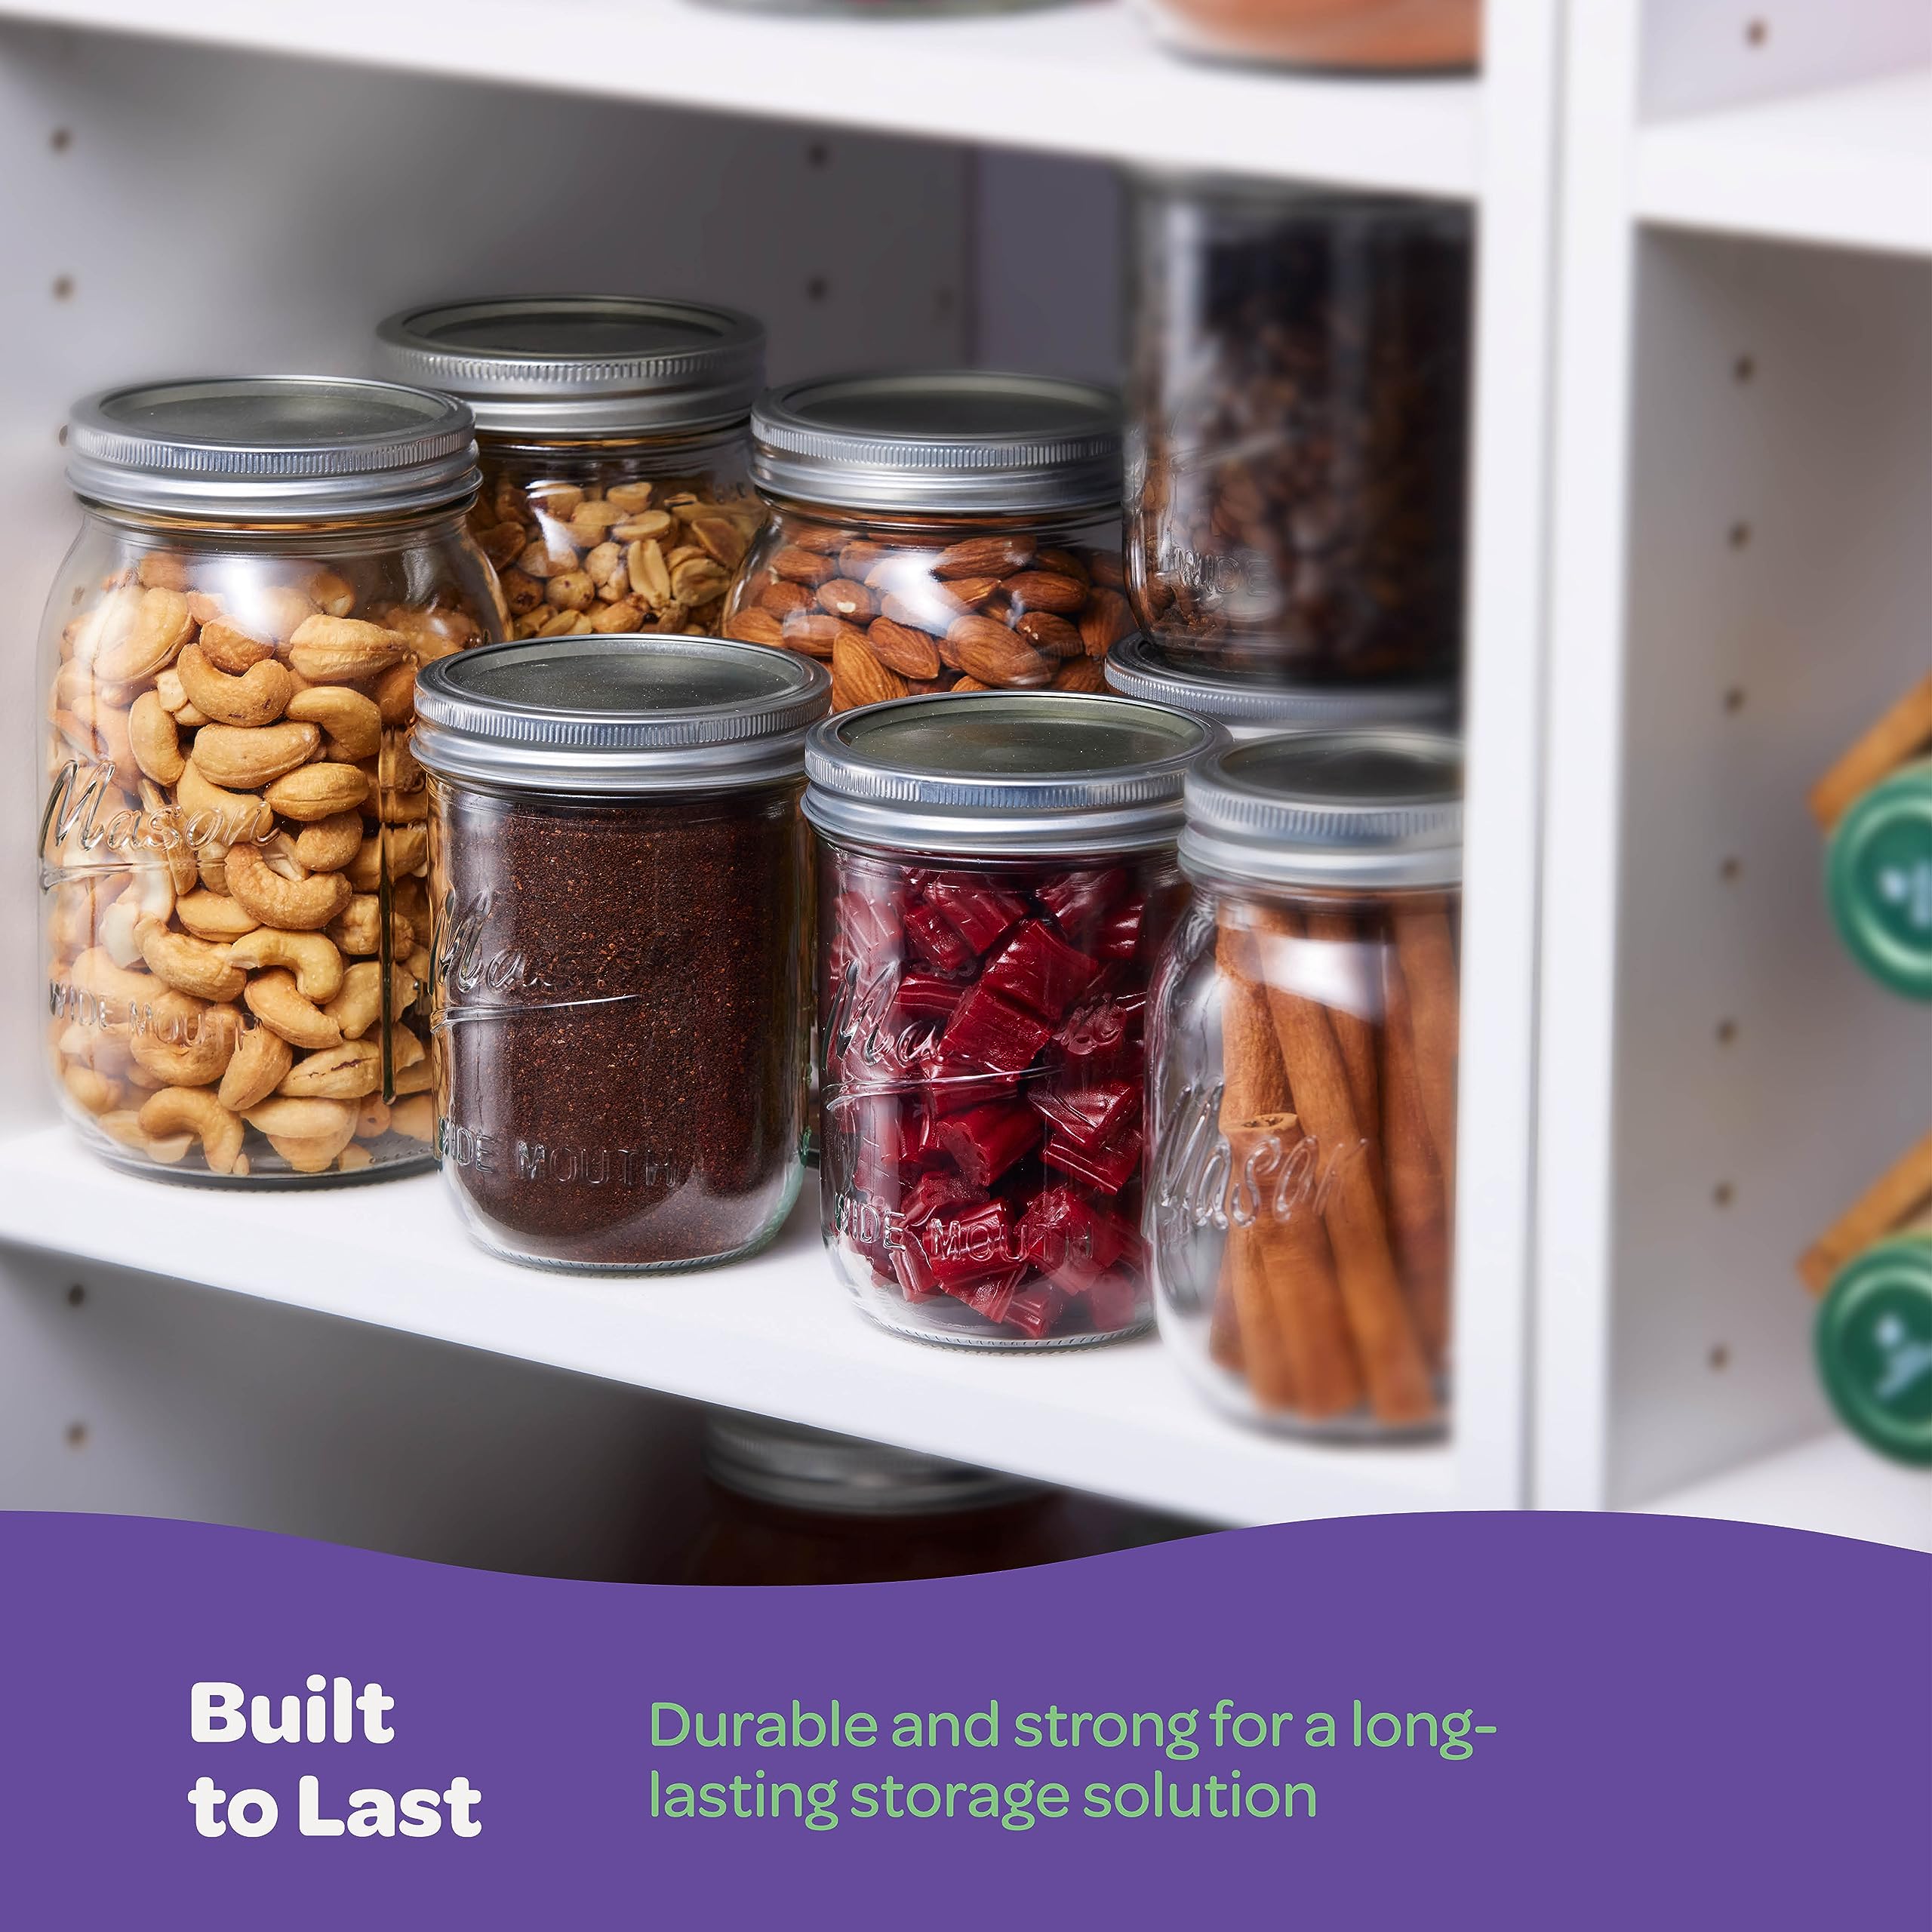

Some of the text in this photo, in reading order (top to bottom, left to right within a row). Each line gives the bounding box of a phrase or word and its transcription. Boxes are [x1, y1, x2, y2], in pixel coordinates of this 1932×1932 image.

[1174, 546, 1270, 598] WIDE
[38, 759, 281, 859] Mason
[48, 978, 111, 1031] WIDE
[518, 1140, 677, 1187] MOUTH
[834, 1191, 1094, 1263] WIDE MOUTH
